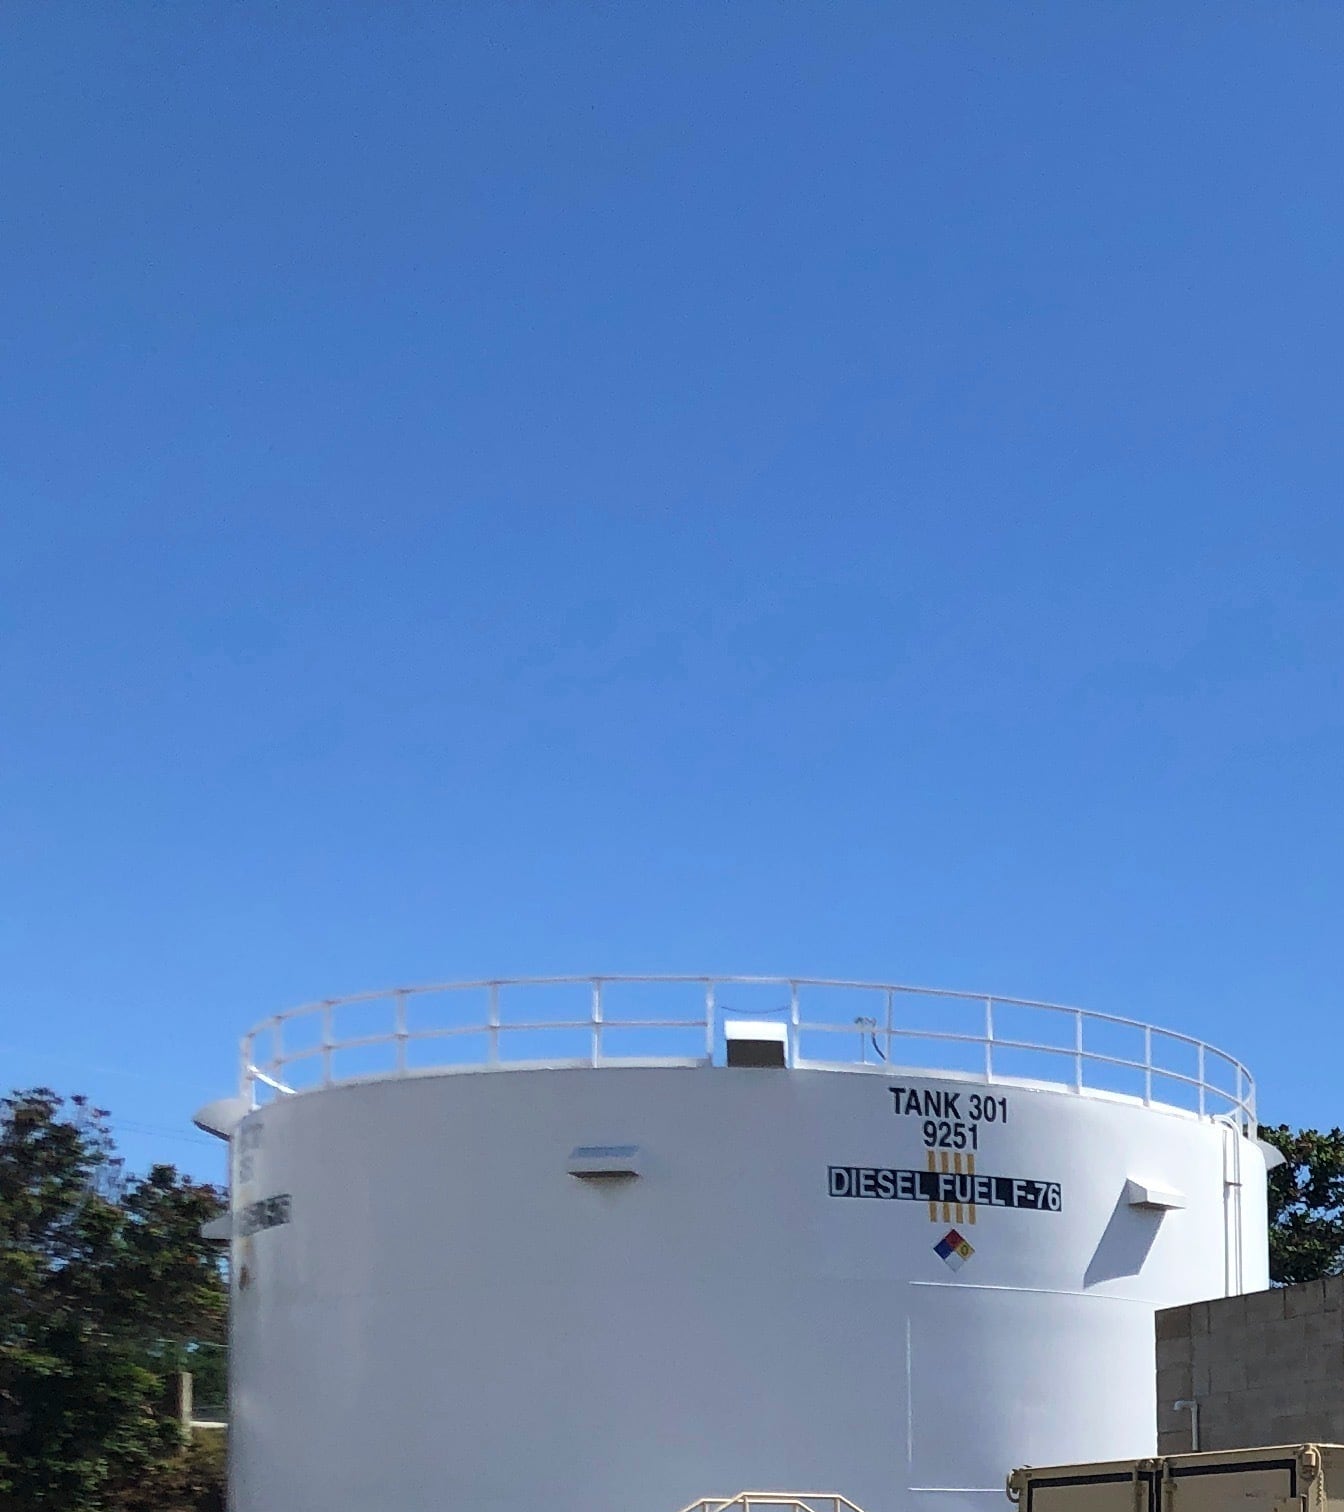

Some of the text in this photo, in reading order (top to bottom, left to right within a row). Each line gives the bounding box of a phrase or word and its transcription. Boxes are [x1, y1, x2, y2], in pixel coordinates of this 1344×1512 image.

[889, 1087, 1007, 1123] TANK 301
[923, 1120, 978, 1150] 9251
[831, 1168, 1061, 1211] DIESEL FUEL F-76
